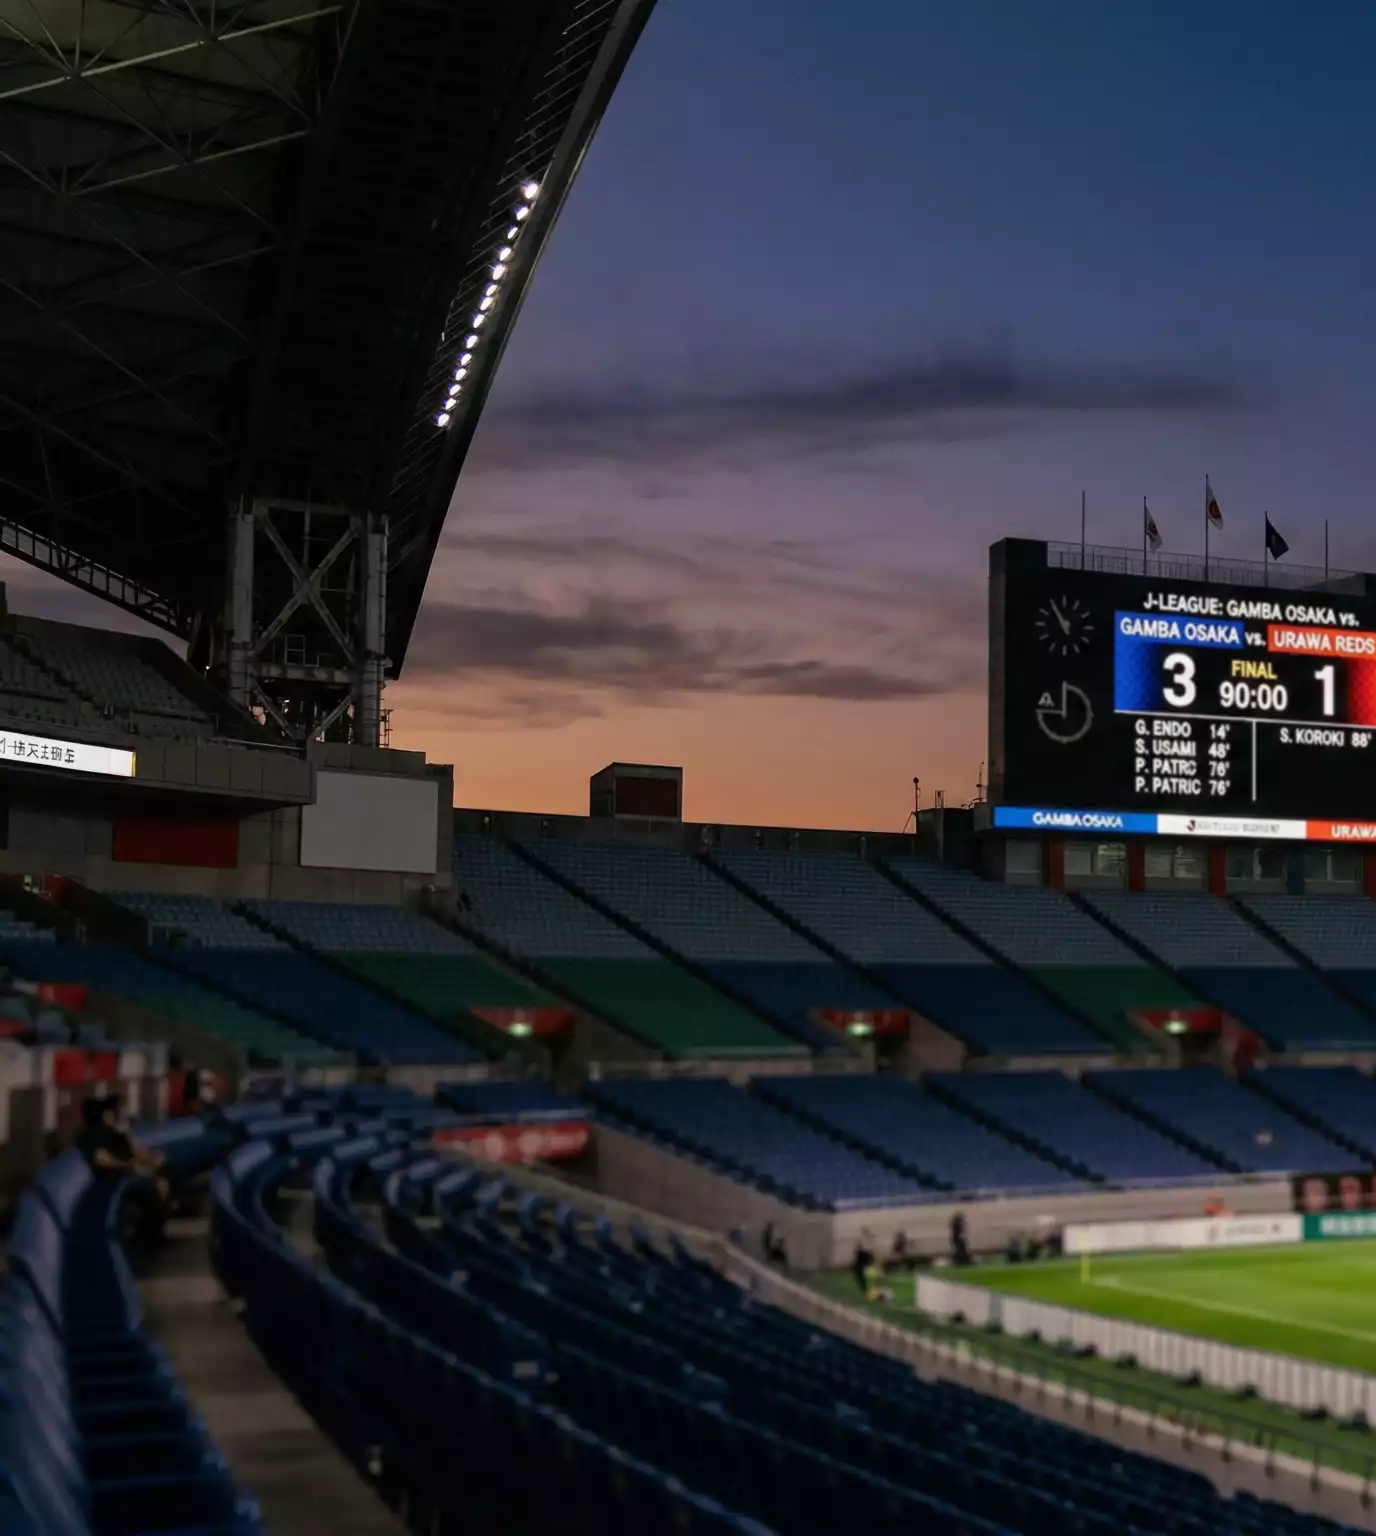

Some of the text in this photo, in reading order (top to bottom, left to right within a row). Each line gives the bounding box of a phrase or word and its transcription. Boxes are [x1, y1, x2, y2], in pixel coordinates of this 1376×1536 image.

[1143, 592, 1360, 627] J-LEAGUE: GAMBA OSAKA vs.
[1120, 617, 1376, 655] GAMBA OSAKA vs. URAWA REDS
[1162, 652, 1197, 708] 3
[1231, 659, 1278, 680] FINAL
[1219, 681, 1288, 711] 90:00
[1314, 664, 1335, 716] 1
[1134, 718, 1150, 736] G.
[1152, 719, 1192, 738] ENDO
[1279, 727, 1293, 744] S.
[1295, 727, 1345, 747] KOROKI
[1135, 737, 1149, 755] S.
[1152, 739, 1197, 758] USAMI
[1135, 756, 1149, 774] P.
[1135, 775, 1149, 793] P.
[1152, 776, 1202, 795] PATRIC
[1032, 811, 1124, 829] GAMBA OSAKA
